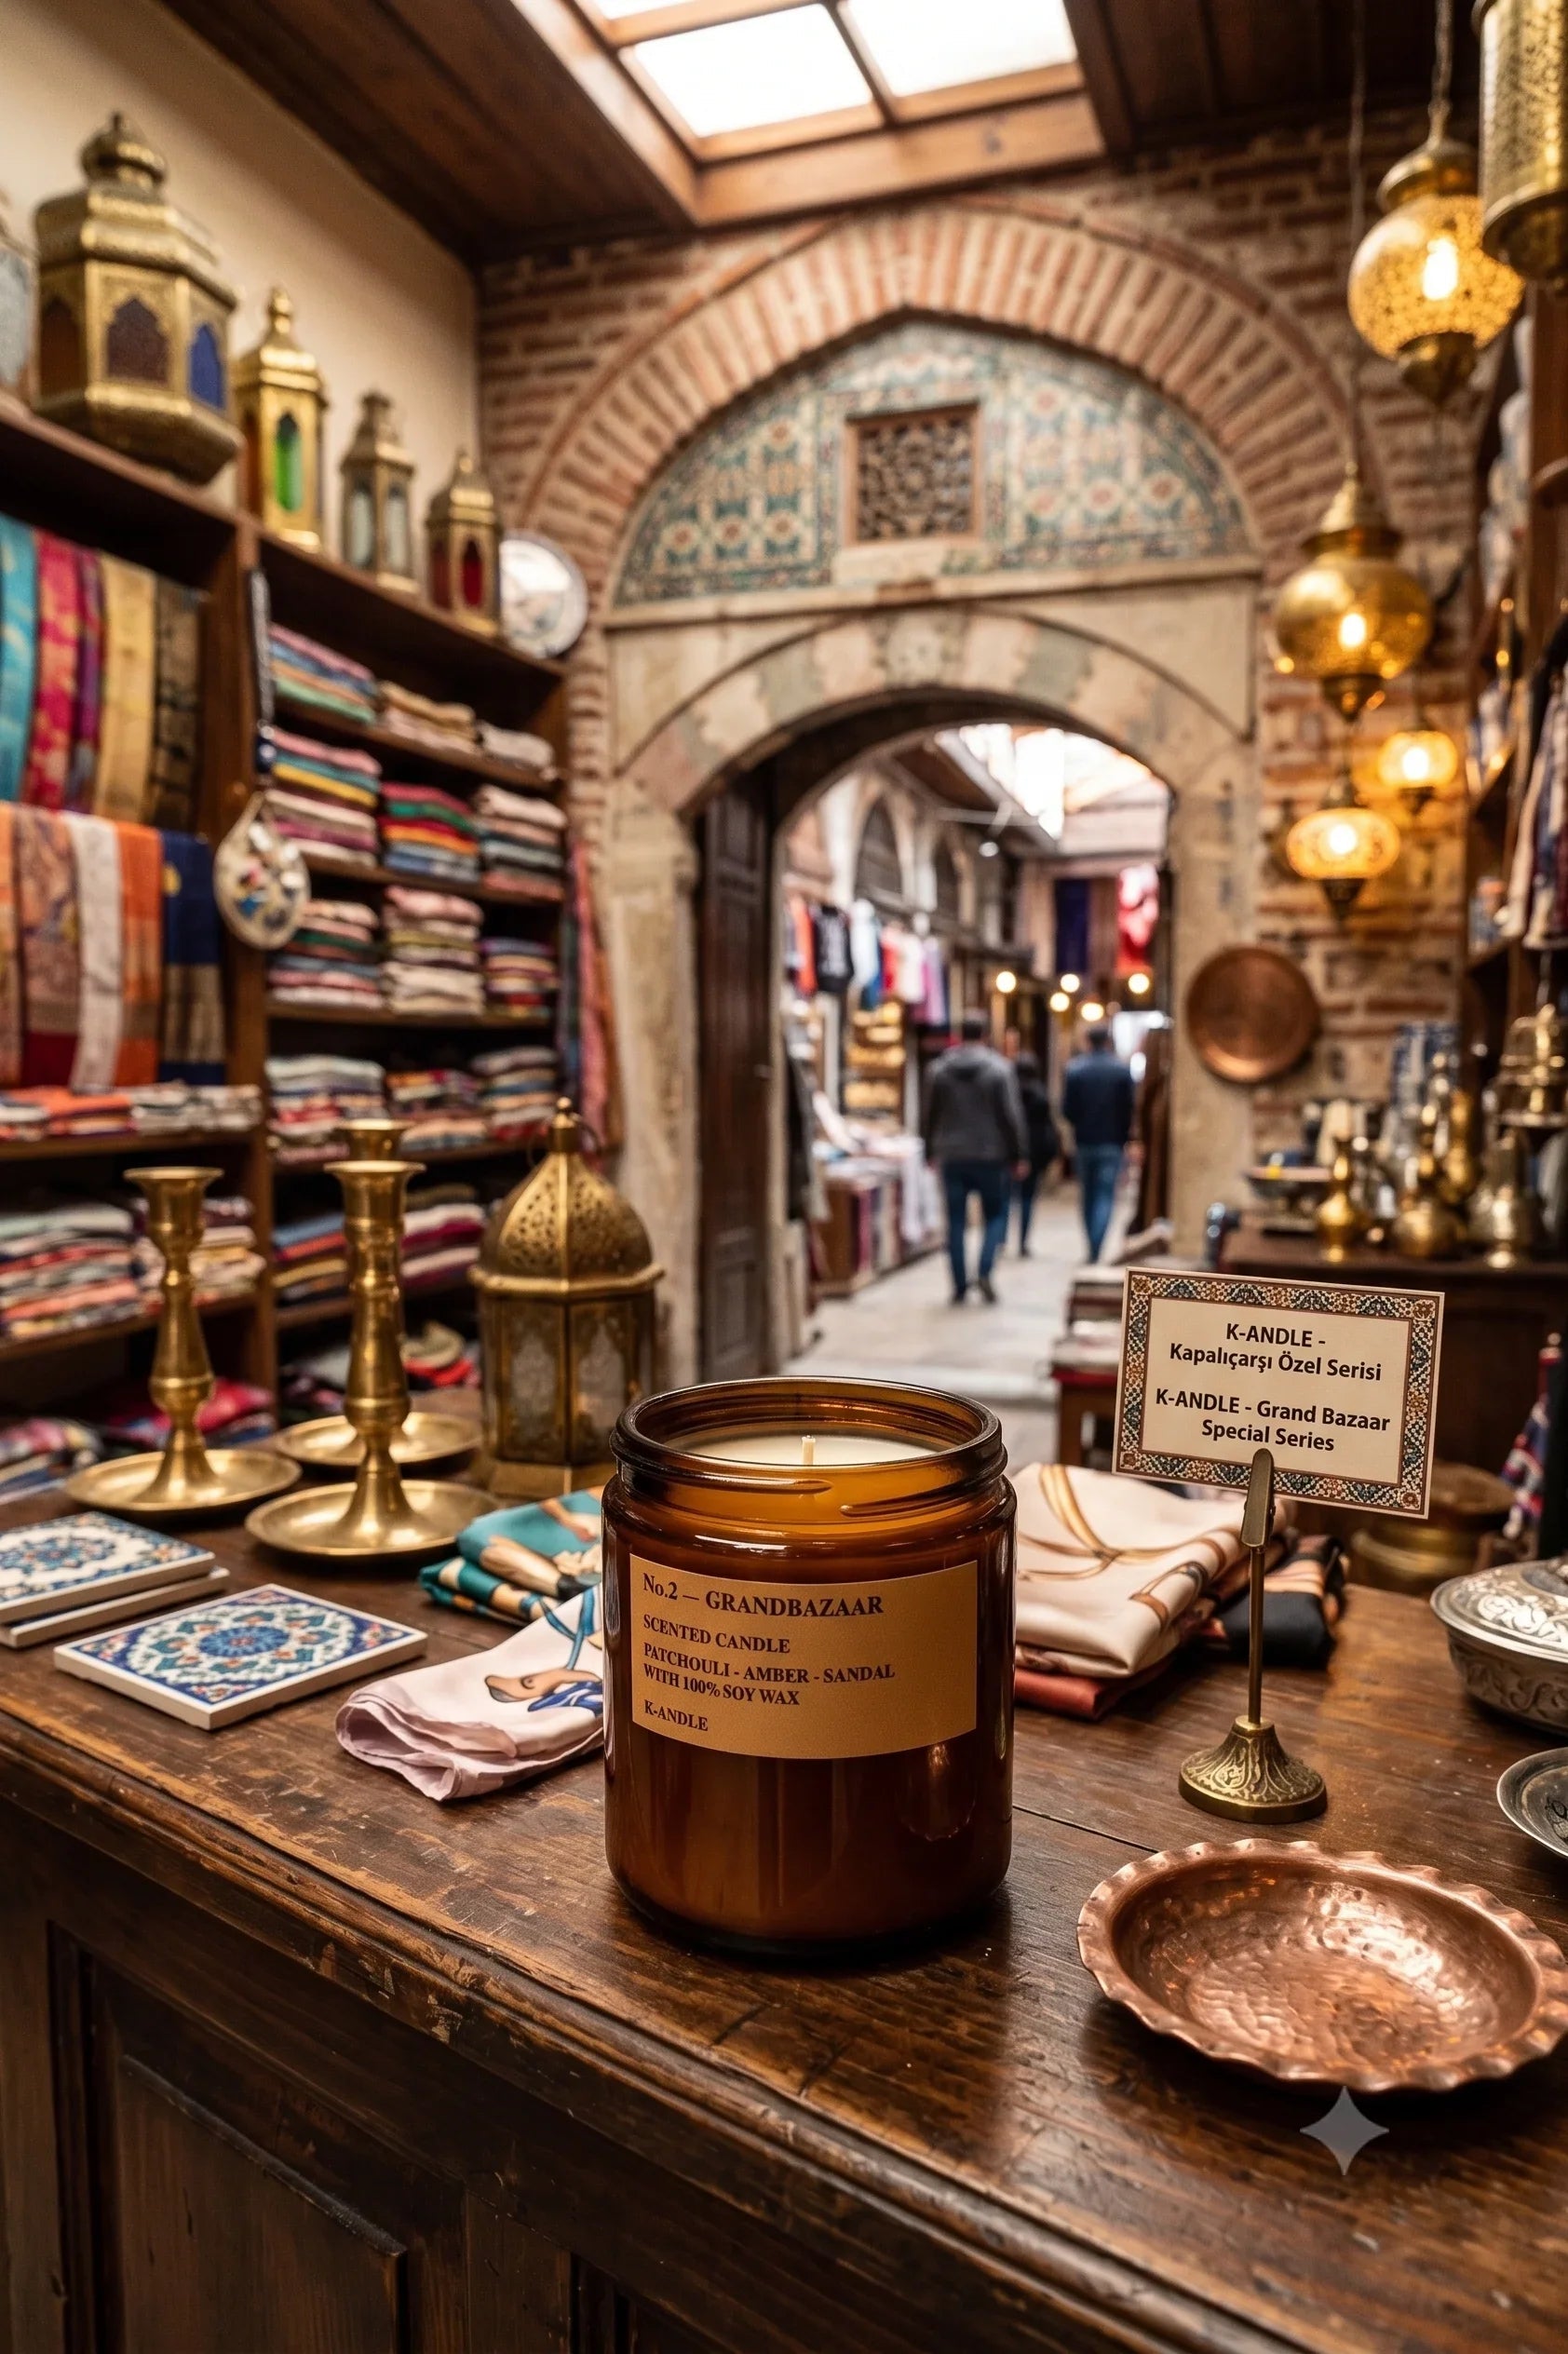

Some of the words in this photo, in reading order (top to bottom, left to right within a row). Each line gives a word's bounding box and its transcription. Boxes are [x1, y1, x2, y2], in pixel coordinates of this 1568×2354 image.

[1226, 1323, 1312, 1347] K-ANDLE
[1170, 1343, 1272, 1373] Kapalıçarşı
[1278, 1350, 1321, 1374] Özel
[1327, 1360, 1382, 1381] Serisi
[1156, 1388, 1239, 1414] K-ANDLE
[1257, 1400, 1317, 1423] Grand
[1322, 1408, 1390, 1431] Bazaar
[1202, 1419, 1270, 1442] Special
[1276, 1428, 1334, 1451] Series
[643, 1573, 678, 1601] No.2
[705, 1590, 884, 1617] GRANDBAZAAR
[643, 1614, 710, 1644] SCENTED
[715, 1632, 790, 1653] CANDLE
[643, 1643, 729, 1676] PATCHOULI
[743, 1666, 809, 1683] AMBER
[823, 1664, 895, 1683] SANDAL
[643, 1663, 679, 1687] WITH
[683, 1676, 720, 1697] 100%
[723, 1684, 755, 1701] SOY
[759, 1688, 800, 1705] WAX
[643, 1699, 709, 1731] K-ANDLE
